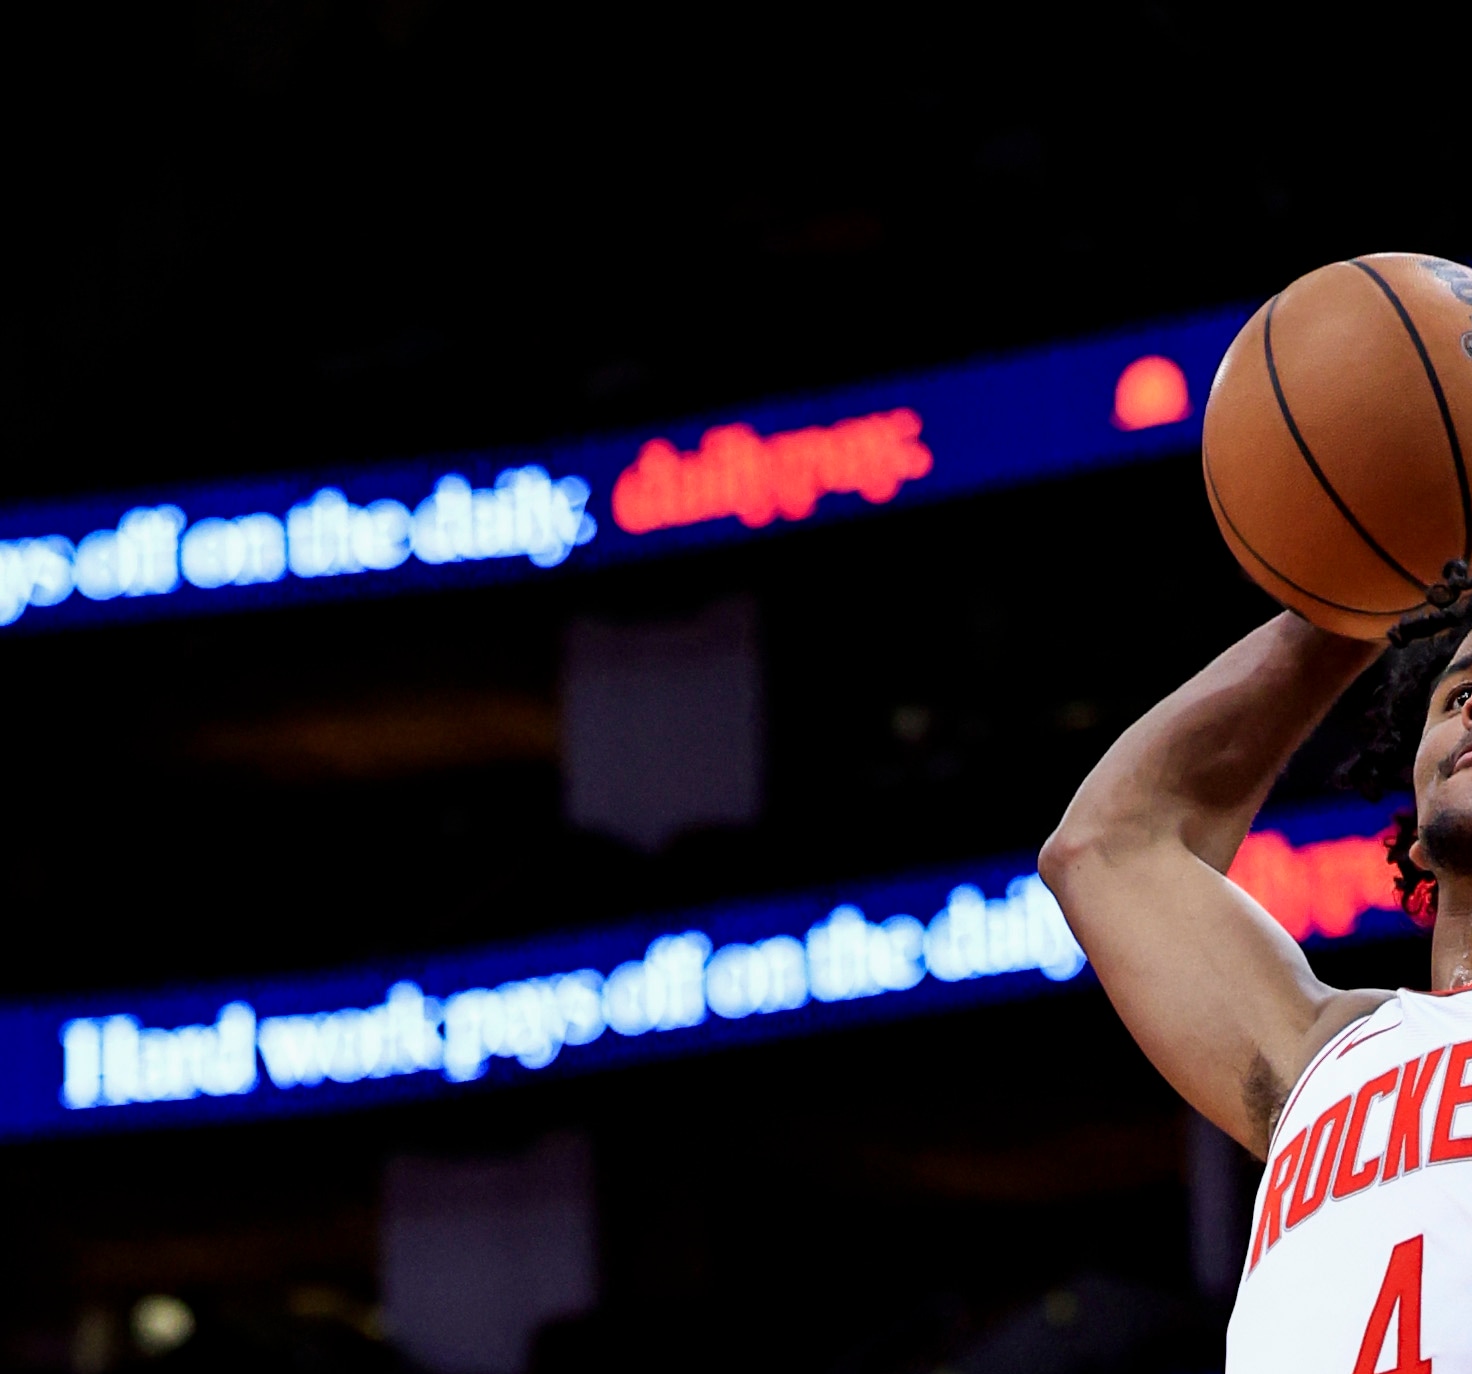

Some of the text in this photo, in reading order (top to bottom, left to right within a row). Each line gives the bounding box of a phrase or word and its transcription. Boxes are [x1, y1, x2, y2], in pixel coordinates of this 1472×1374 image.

[61, 1001, 258, 1110] Hard
[256, 980, 447, 1087] work
[444, 968, 610, 1083] pays
[605, 930, 710, 1036] off
[705, 935, 809, 1019] on
[807, 904, 927, 1002] the
